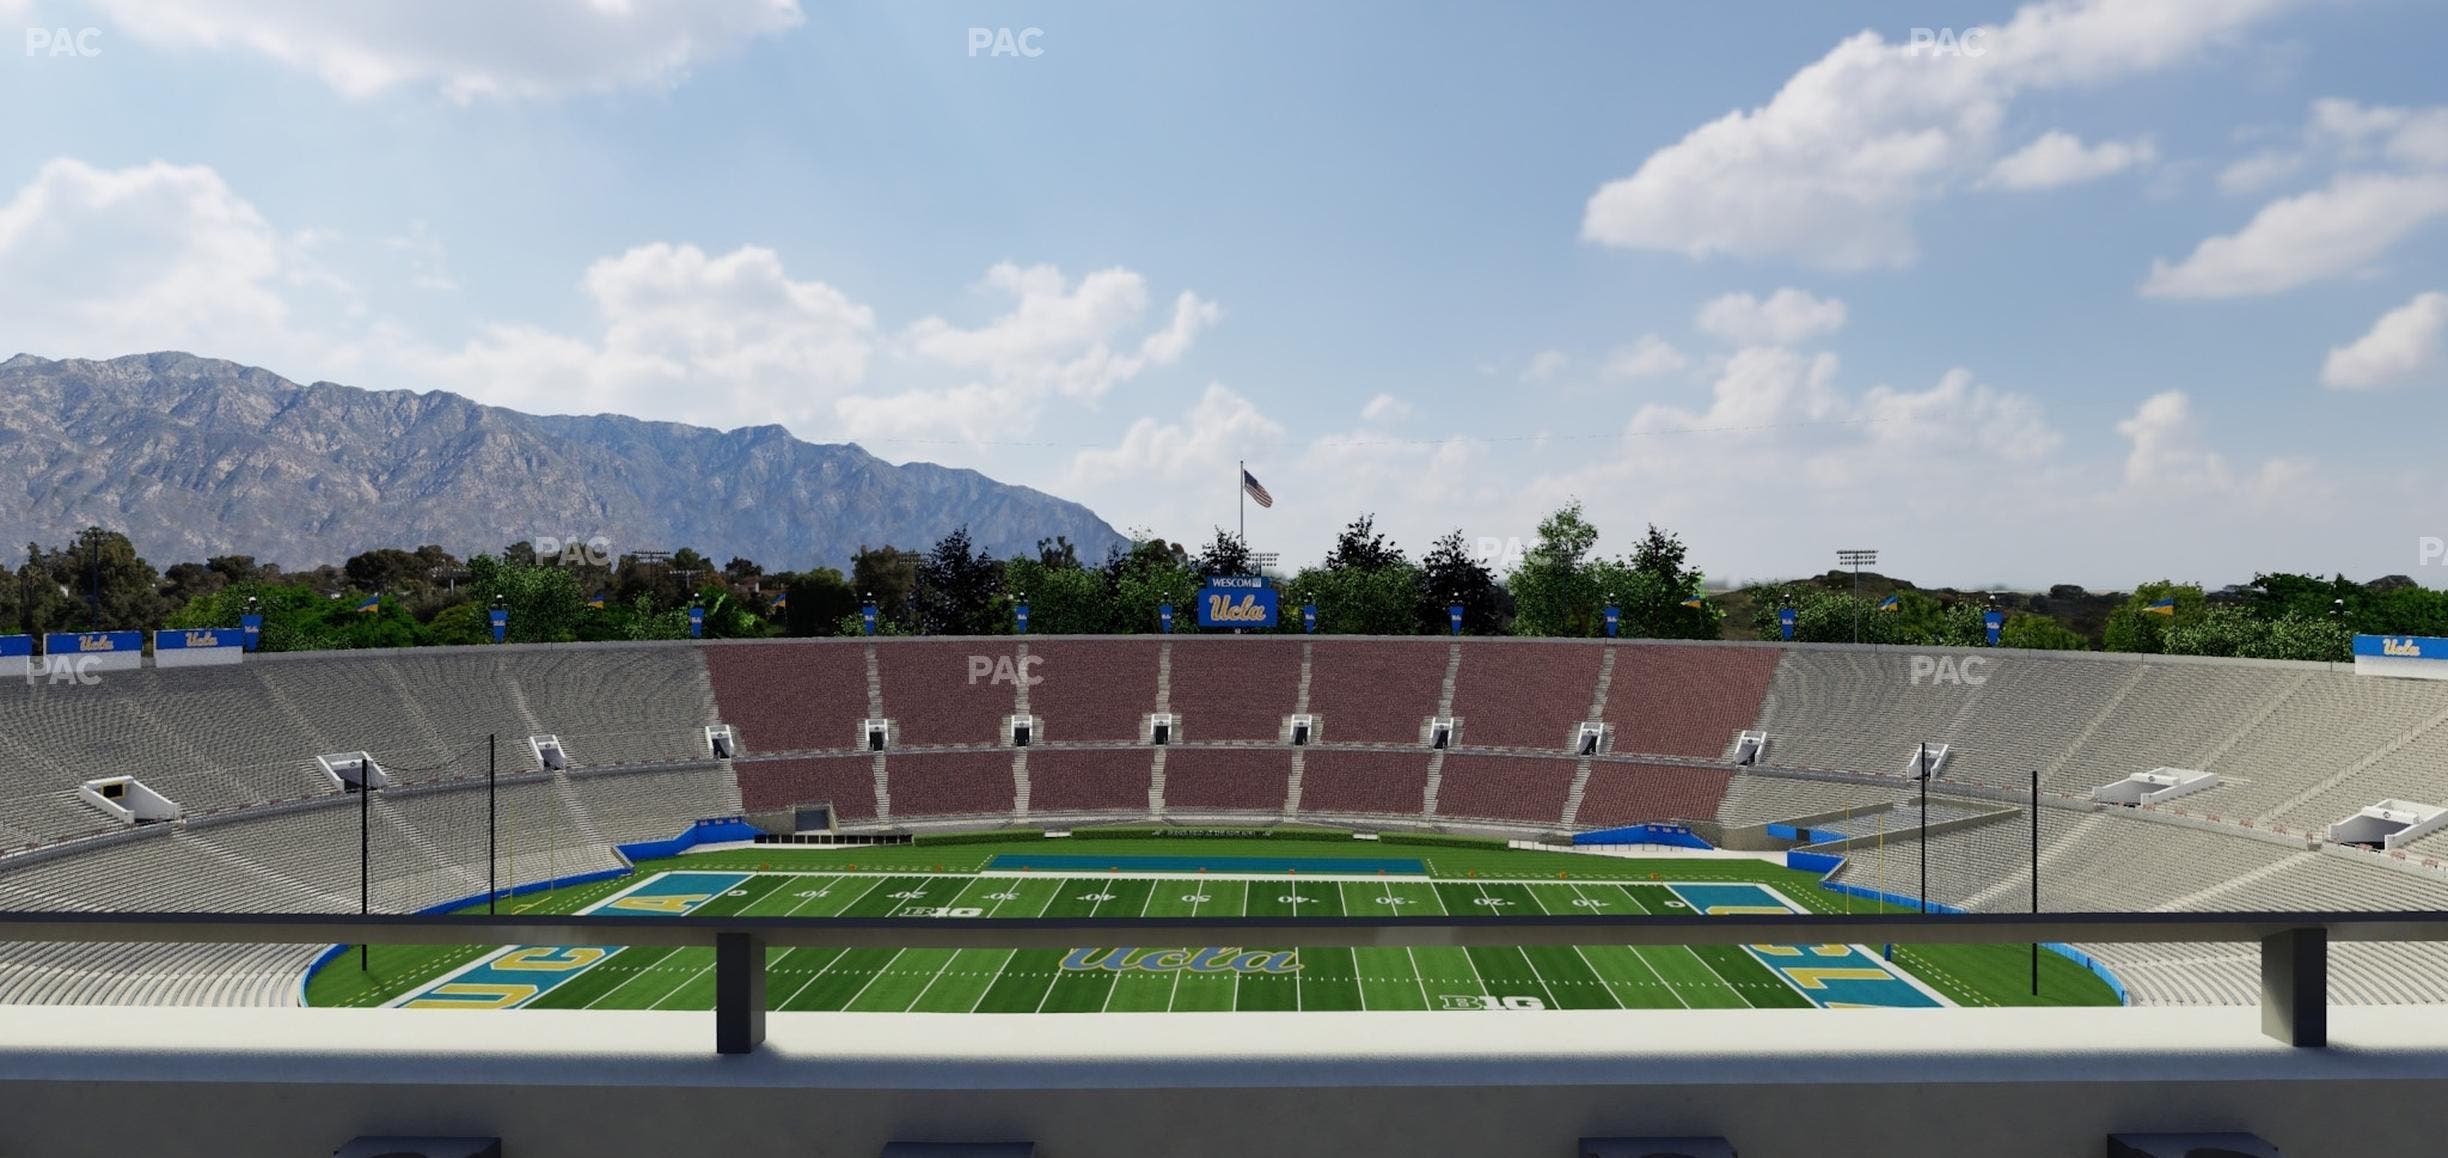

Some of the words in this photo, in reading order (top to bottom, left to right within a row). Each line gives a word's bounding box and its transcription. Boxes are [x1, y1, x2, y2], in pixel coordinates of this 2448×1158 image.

[1213, 577, 1252, 588] WESCOM
[1084, 893, 1117, 902] 40
[1181, 895, 1212, 903] 50
[1277, 895, 1310, 903] 40
[1375, 896, 1406, 905] 30
[1473, 897, 1505, 906] 20
